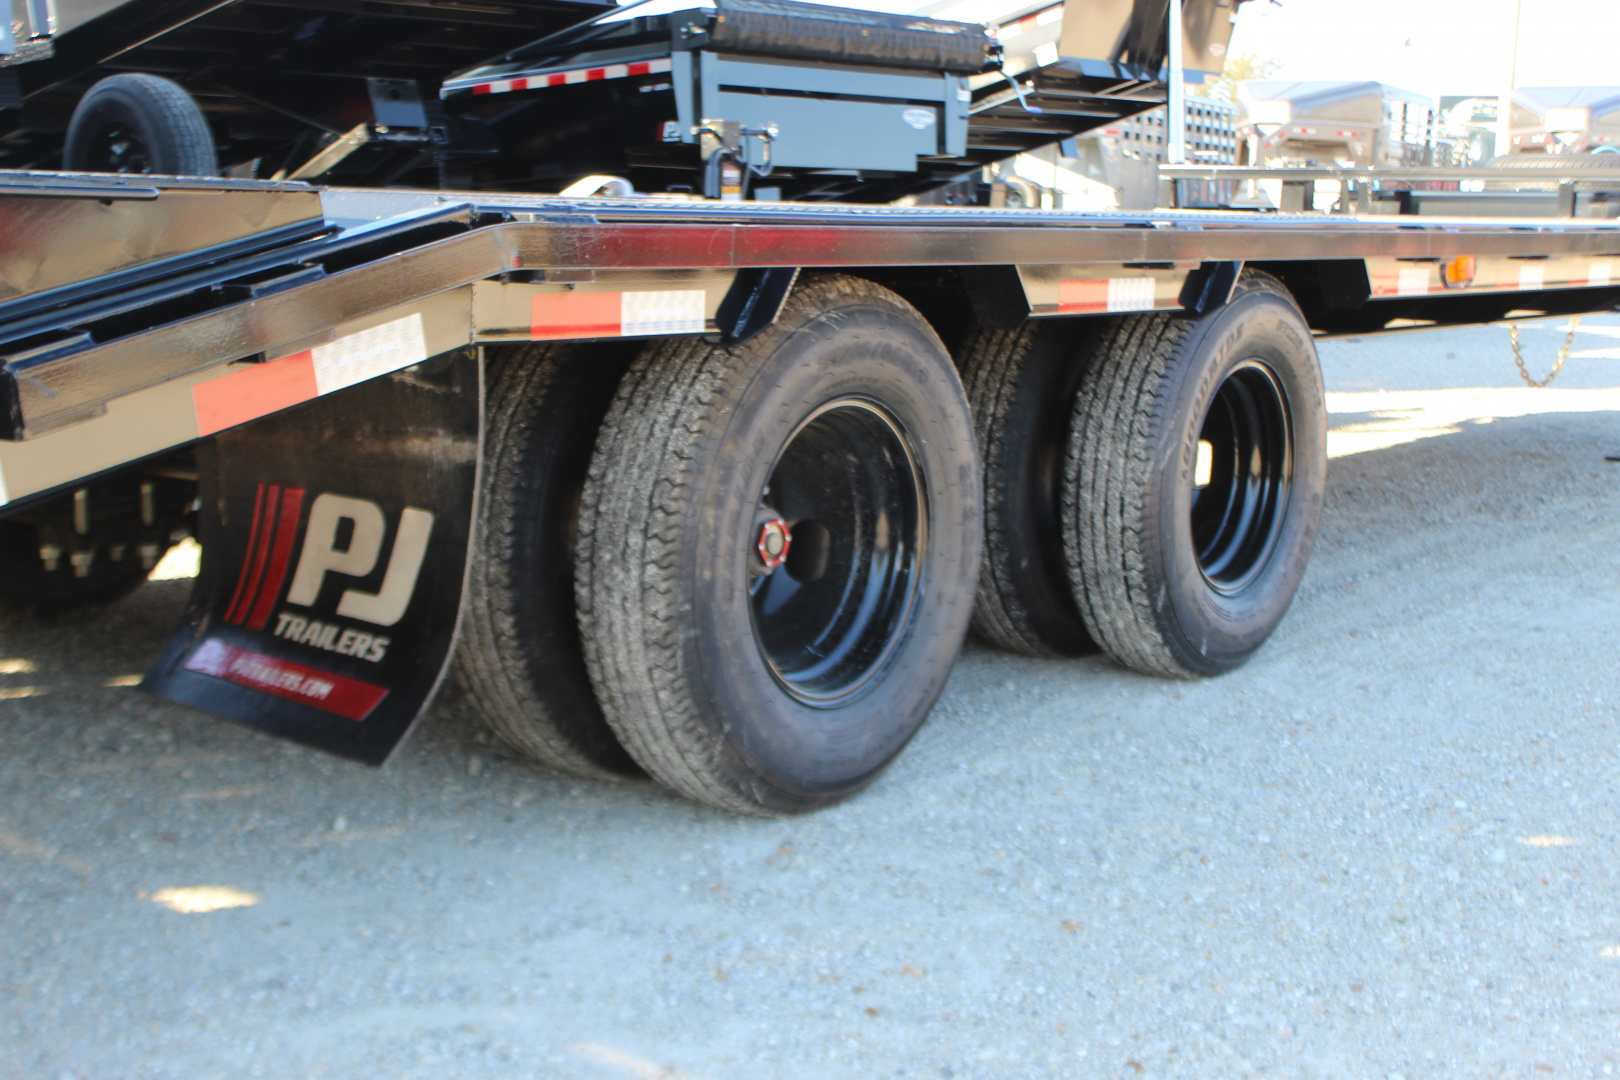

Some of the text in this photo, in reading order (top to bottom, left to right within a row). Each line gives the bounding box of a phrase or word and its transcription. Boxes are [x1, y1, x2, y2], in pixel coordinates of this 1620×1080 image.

[1182, 322, 1246, 469] GOODRIDE
[286, 492, 434, 626] PJ
[273, 612, 390, 663] TRAILERS
